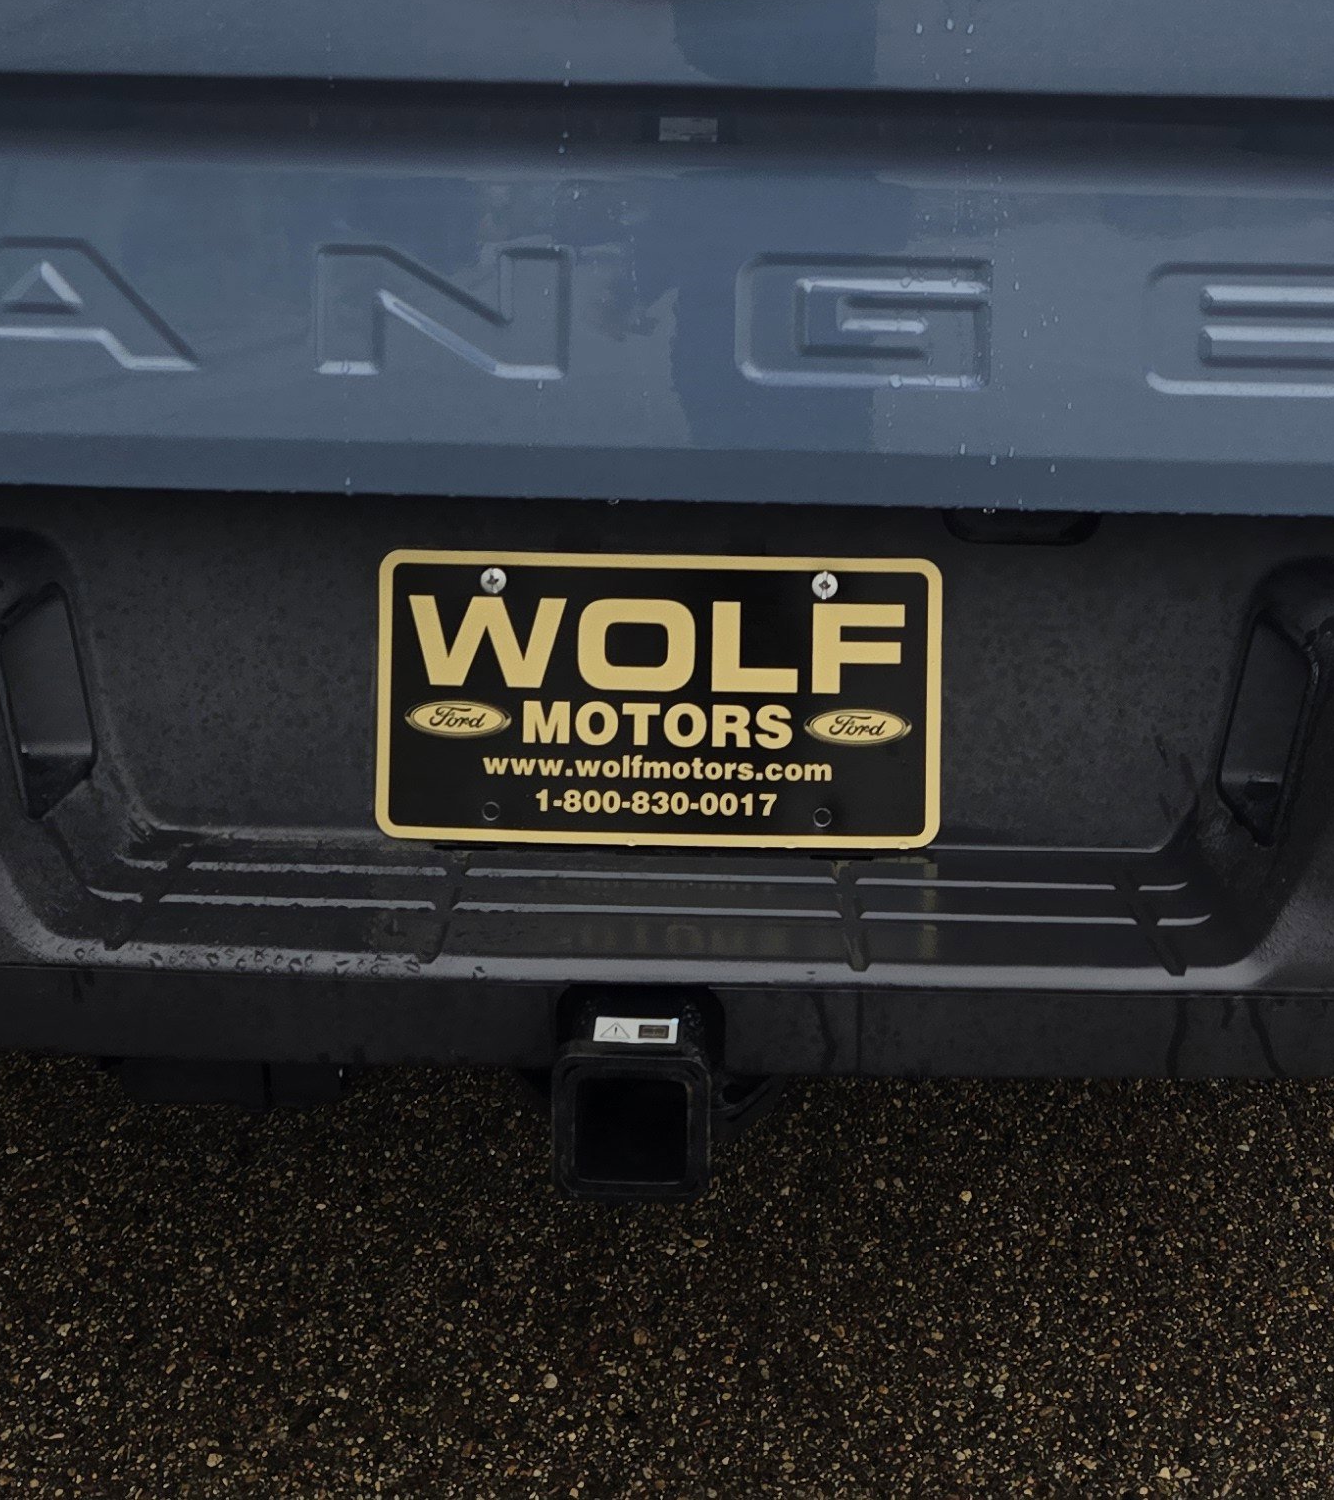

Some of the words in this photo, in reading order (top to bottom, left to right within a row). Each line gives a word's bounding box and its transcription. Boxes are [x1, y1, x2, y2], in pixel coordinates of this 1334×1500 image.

[408, 594, 906, 695] WOLF
[429, 705, 487, 729] Ford
[522, 700, 794, 750] MOTORS
[828, 714, 886, 737] Ford
[482, 755, 833, 783] www.wolfmotors.com
[534, 788, 778, 818] 1-800-830-0017
